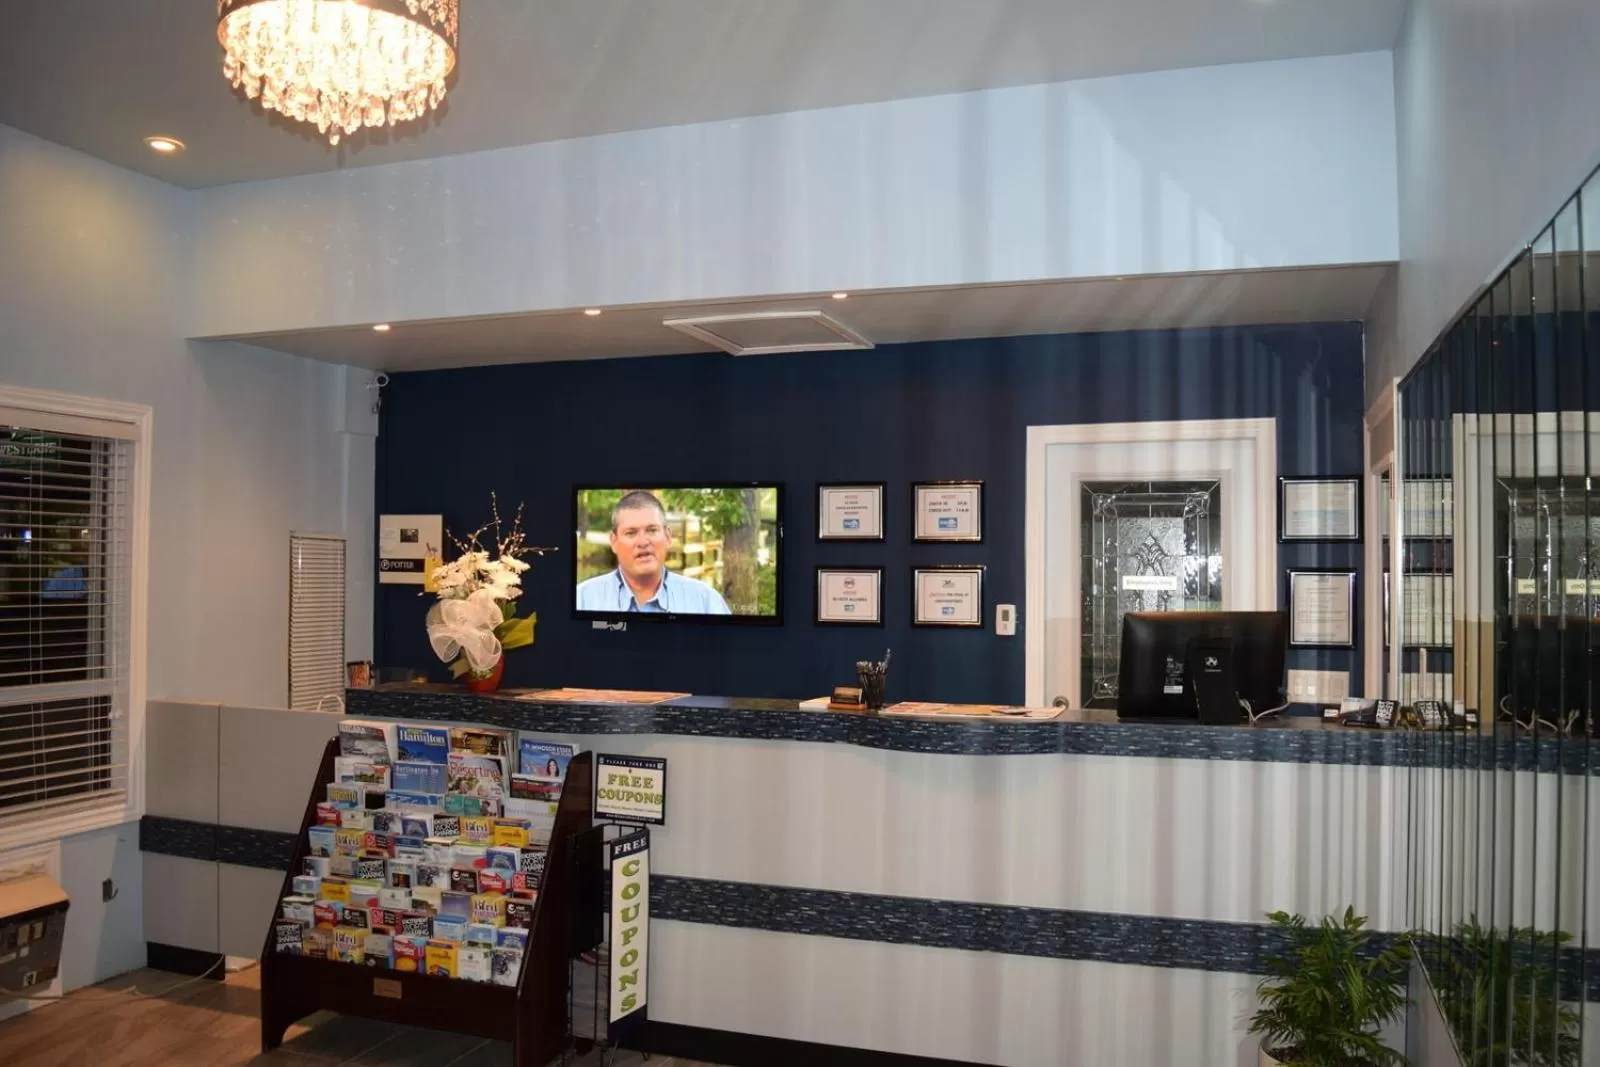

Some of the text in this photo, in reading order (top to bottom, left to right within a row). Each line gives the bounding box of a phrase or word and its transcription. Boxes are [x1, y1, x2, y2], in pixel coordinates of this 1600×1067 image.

[607, 773, 654, 789] FREE
[598, 787, 663, 805] COUPONS
[614, 836, 648, 855] FREE
[618, 858, 641, 1013] COUPONS
